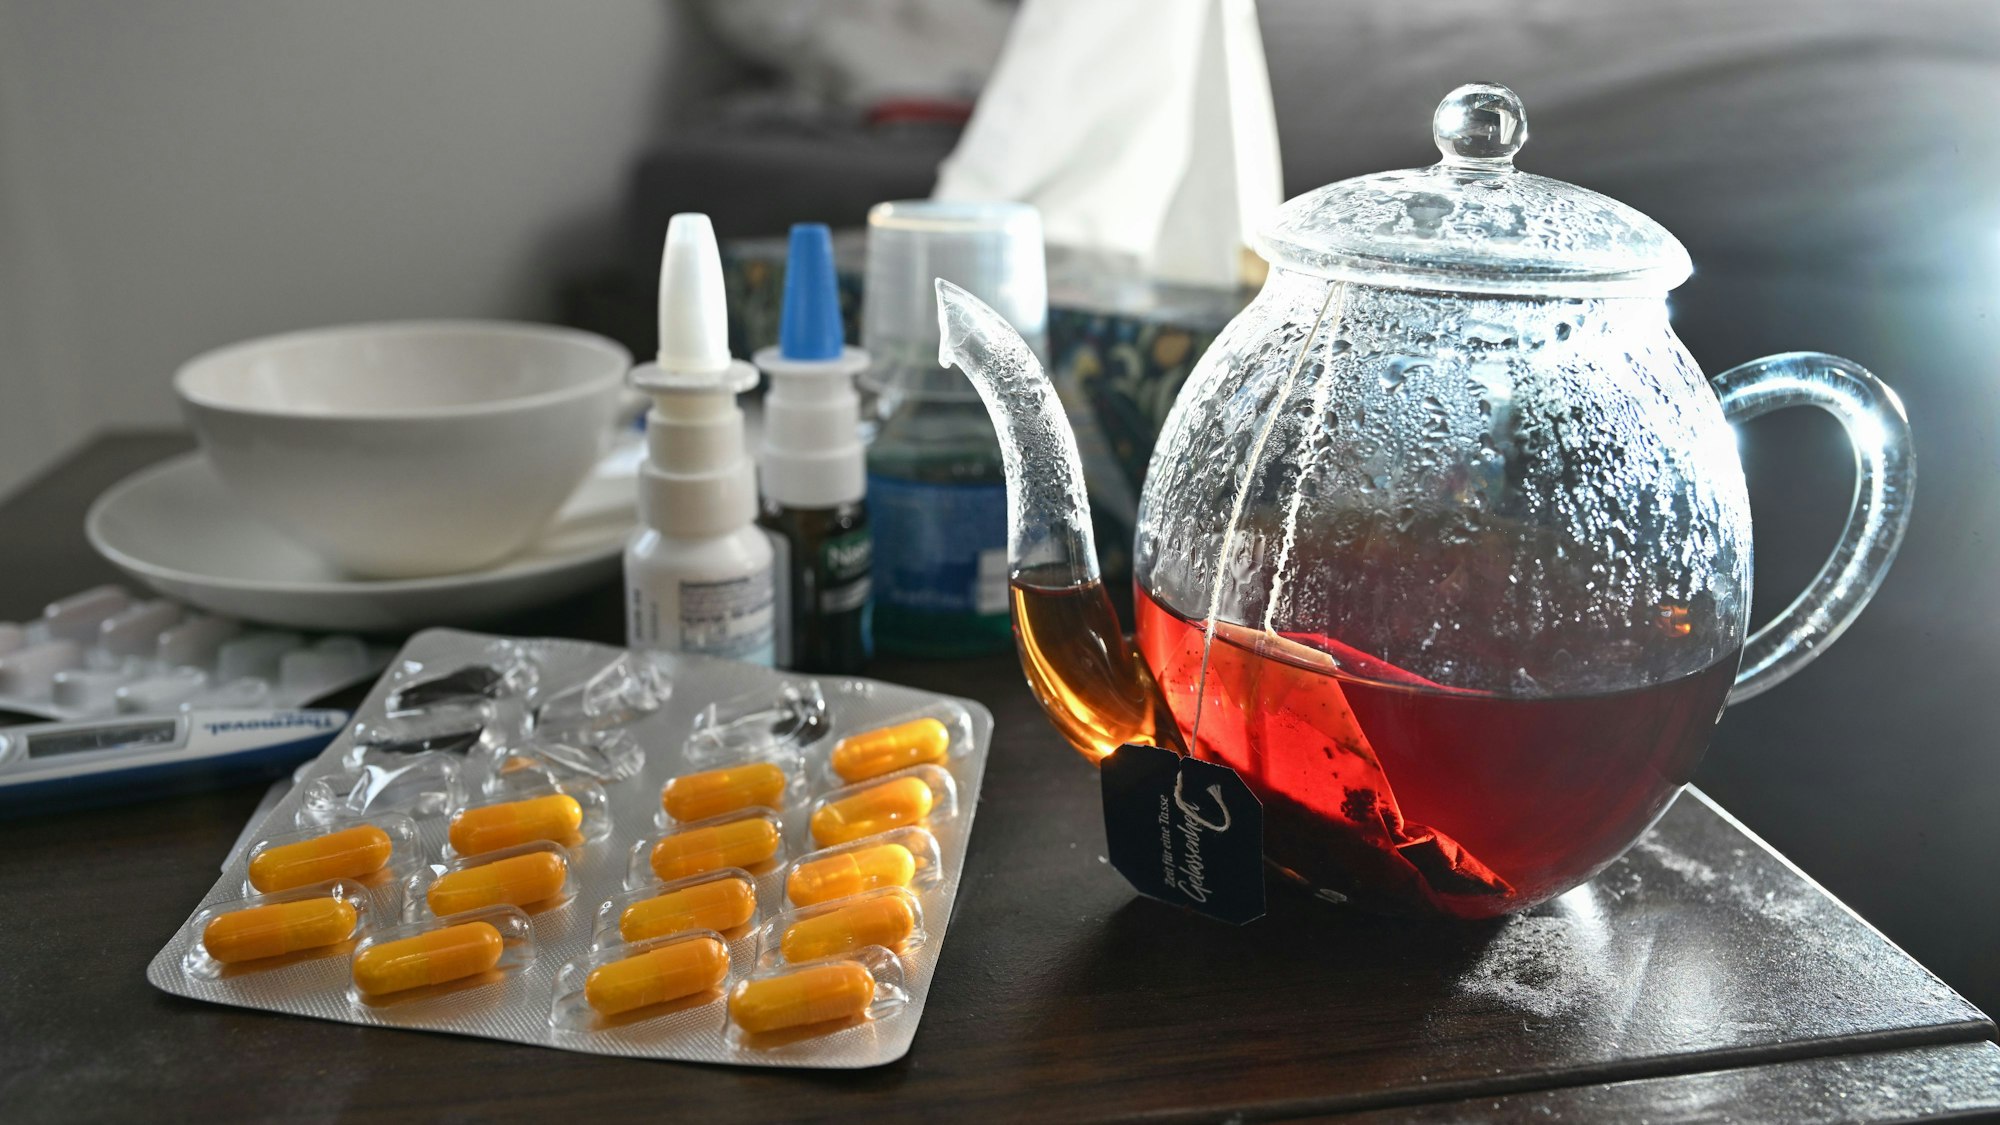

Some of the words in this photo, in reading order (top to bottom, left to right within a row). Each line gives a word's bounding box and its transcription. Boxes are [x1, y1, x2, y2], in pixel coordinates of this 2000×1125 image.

[1159, 794, 1170, 825] Tasse
[1161, 826, 1172, 849] eine
[1162, 849, 1176, 868] für
[1177, 801, 1213, 903] Gelassenhet
[1165, 866, 1176, 888] Zeit
